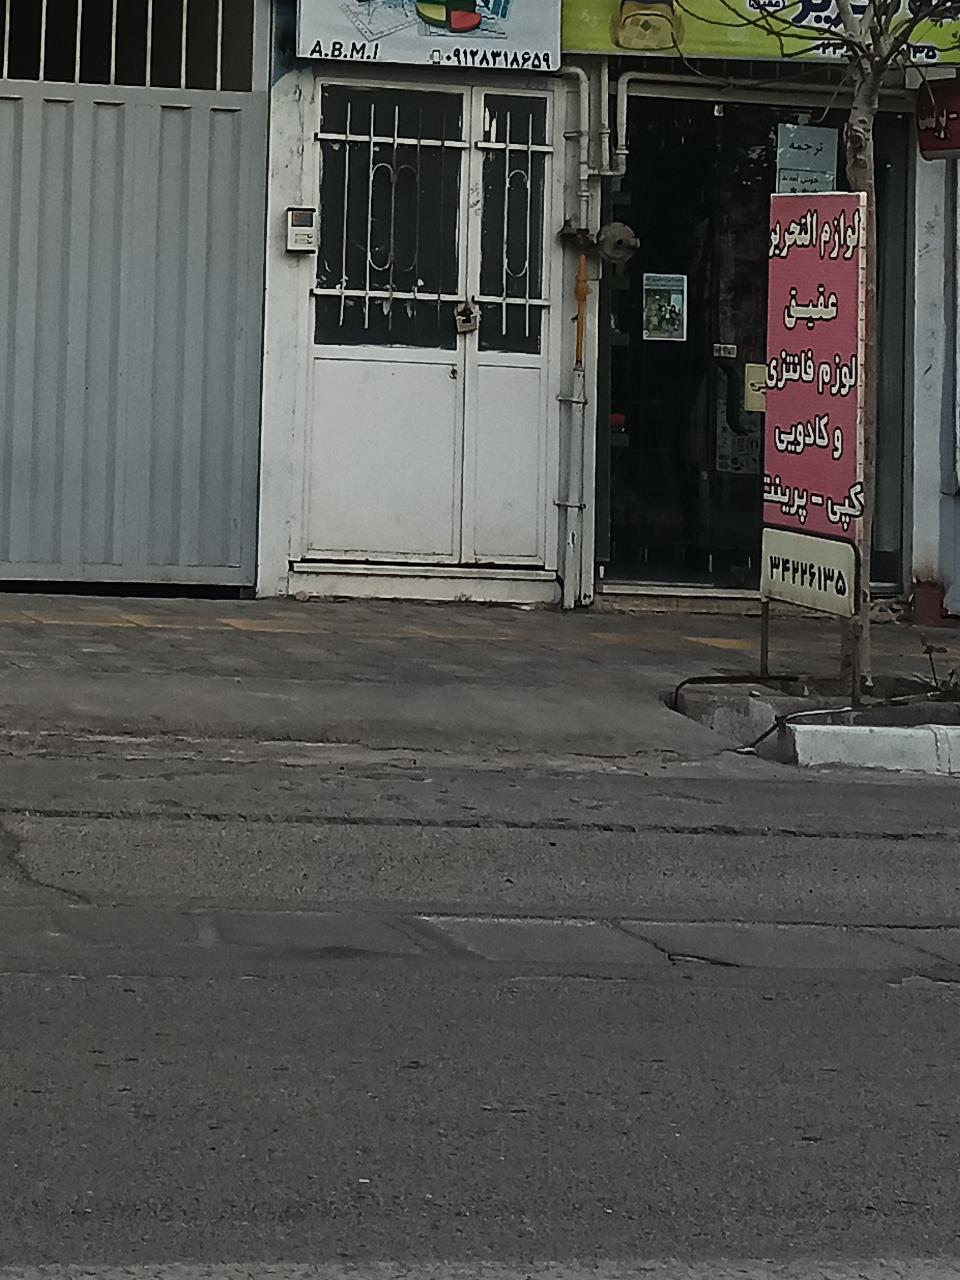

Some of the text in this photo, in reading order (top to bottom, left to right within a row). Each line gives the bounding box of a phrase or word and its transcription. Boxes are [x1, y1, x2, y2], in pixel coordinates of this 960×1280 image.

[768, 208, 817, 259] التحریر
[820, 208, 860, 259] لوازم
[784, 285, 838, 329] عقیق
[766, 349, 814, 389] فانتزی
[774, 414, 844, 460] و کادویی
[763, 475, 808, 525] پرینت
[826, 482, 863, 532] کپی
[769, 555, 847, 597] ۳۴۲۲۶۱۳۵
